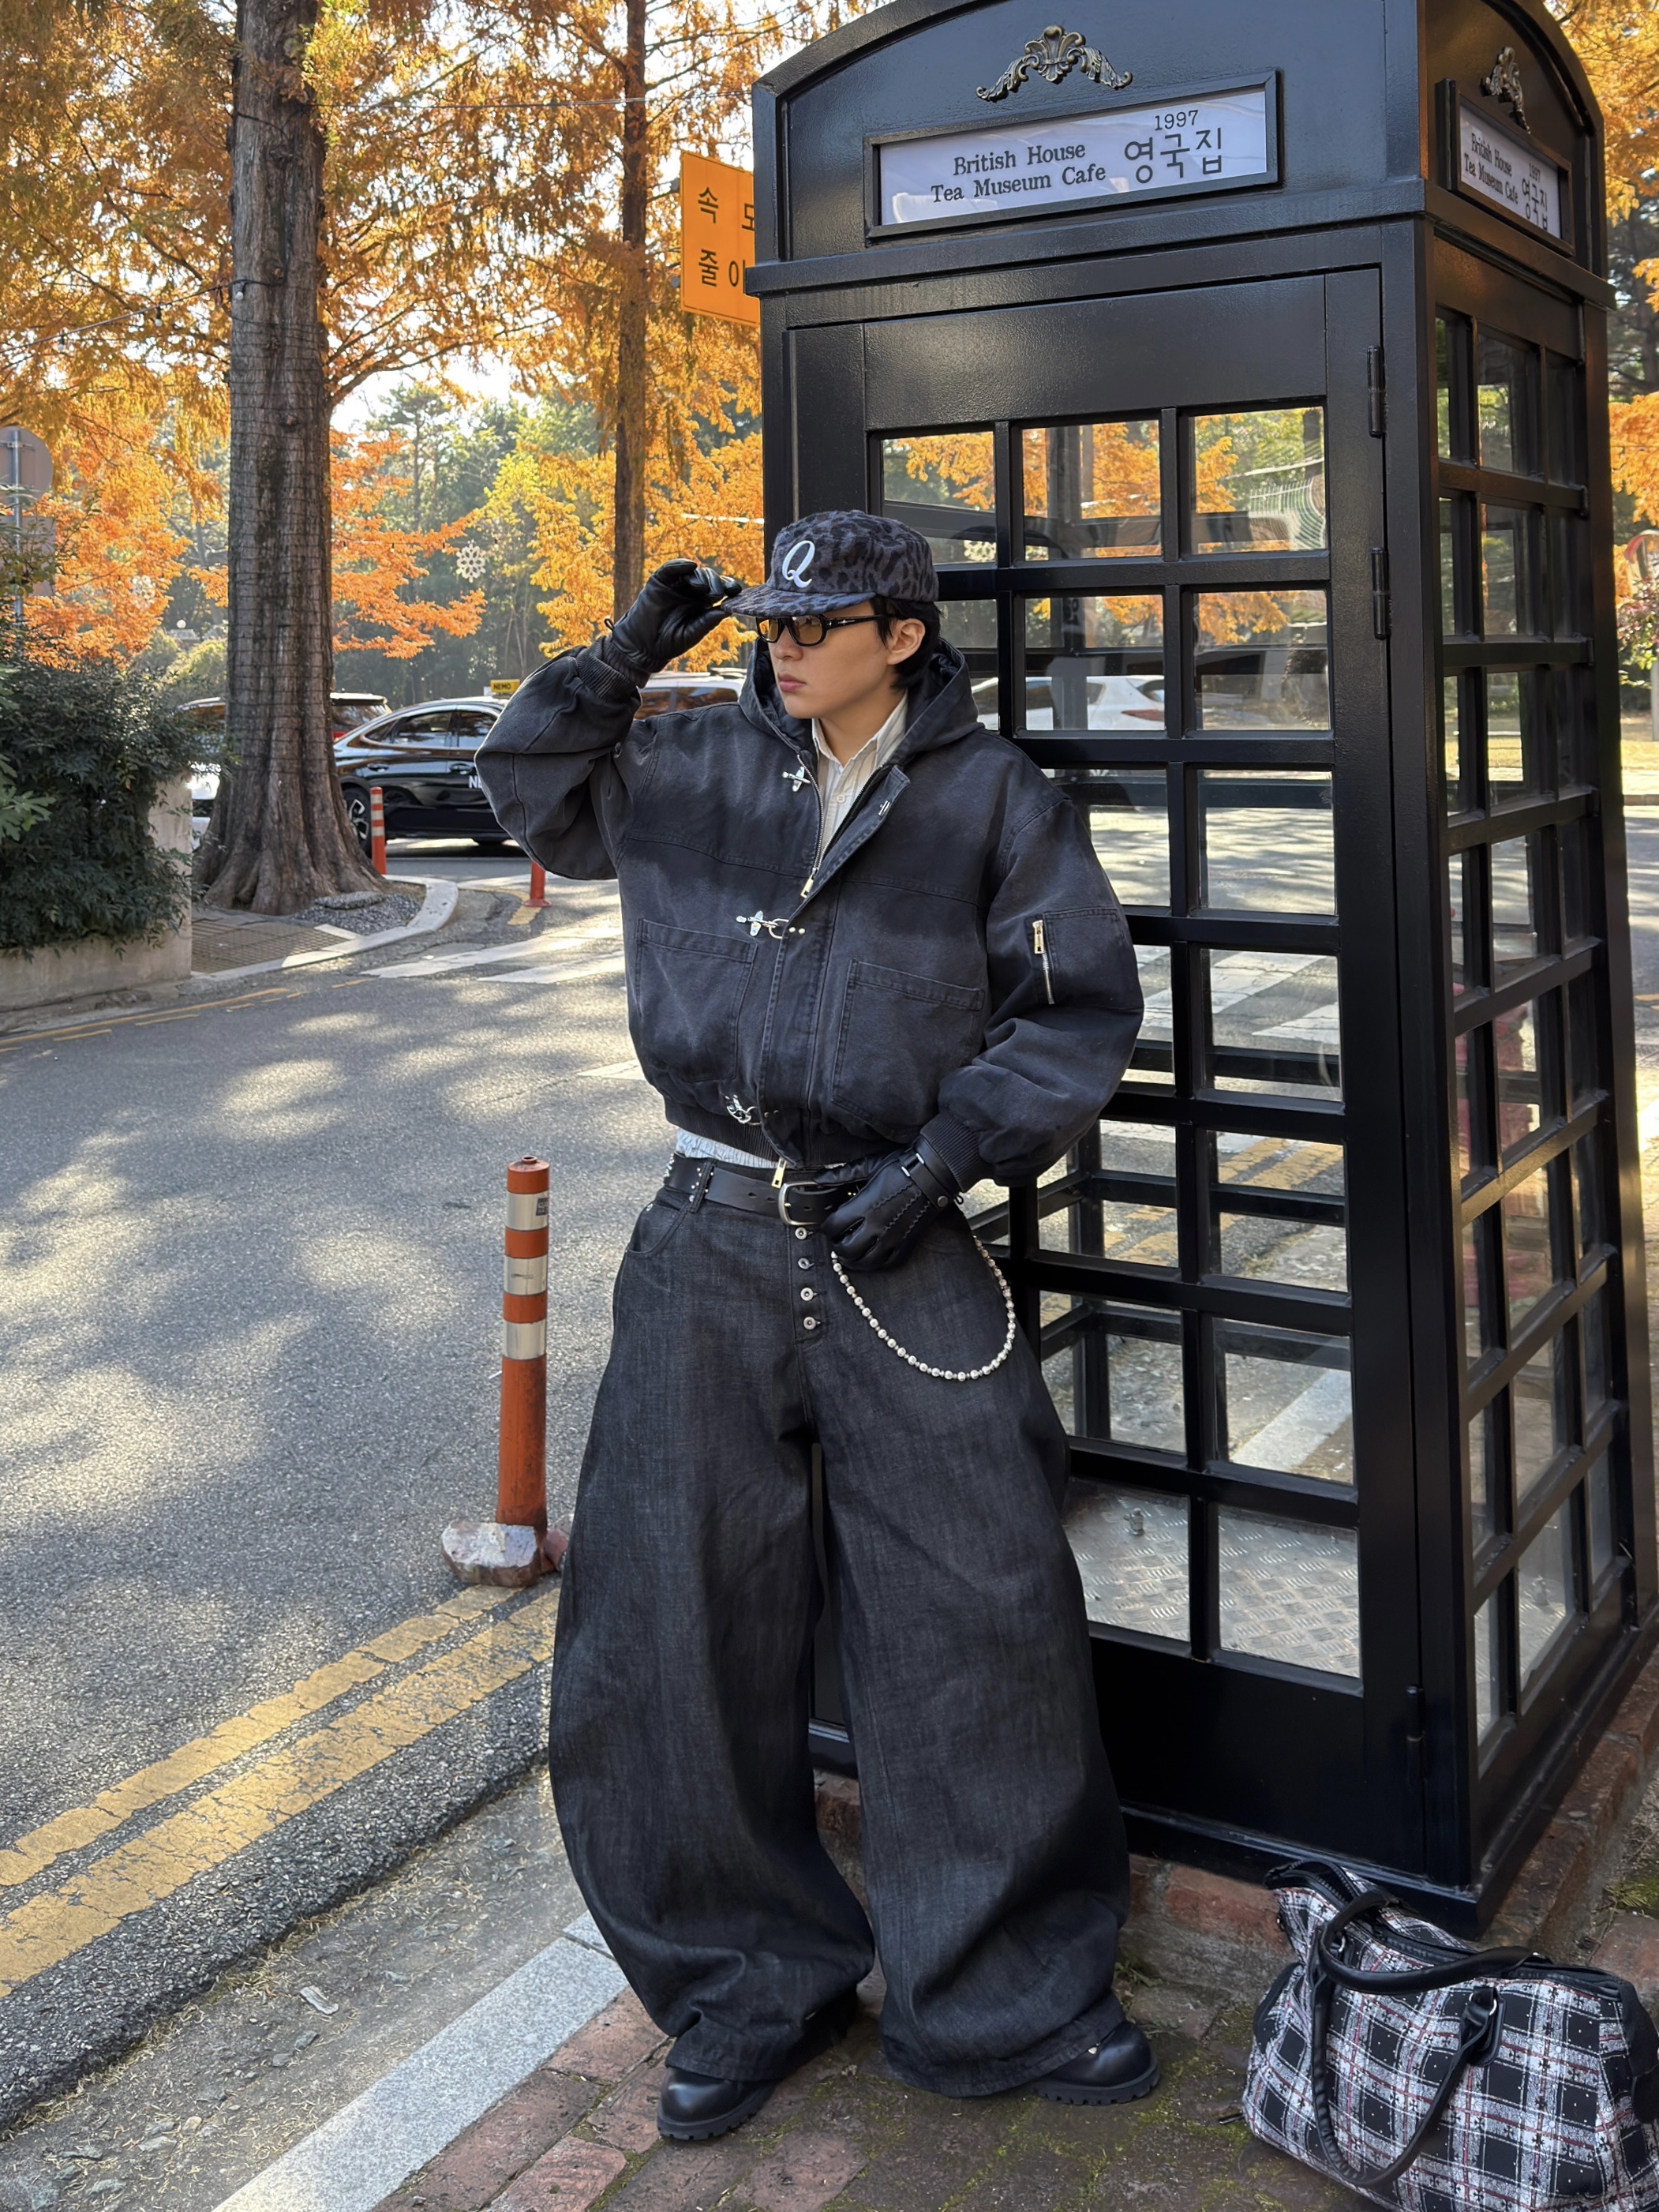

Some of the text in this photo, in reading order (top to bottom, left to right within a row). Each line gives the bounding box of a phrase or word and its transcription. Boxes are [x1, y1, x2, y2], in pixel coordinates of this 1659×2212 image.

[1154, 110, 1199, 131] 1997
[953, 144, 1086, 176] British House
[1124, 127, 1223, 184] 영국집
[1471, 133, 1513, 177] British House
[1528, 162, 1541, 182] 1997
[931, 163, 1107, 203] Tea Museum Cafe
[1464, 152, 1519, 204] Tea Museum Cafe
[1522, 178, 1548, 231] 영국집
[782, 540, 815, 588] Q
